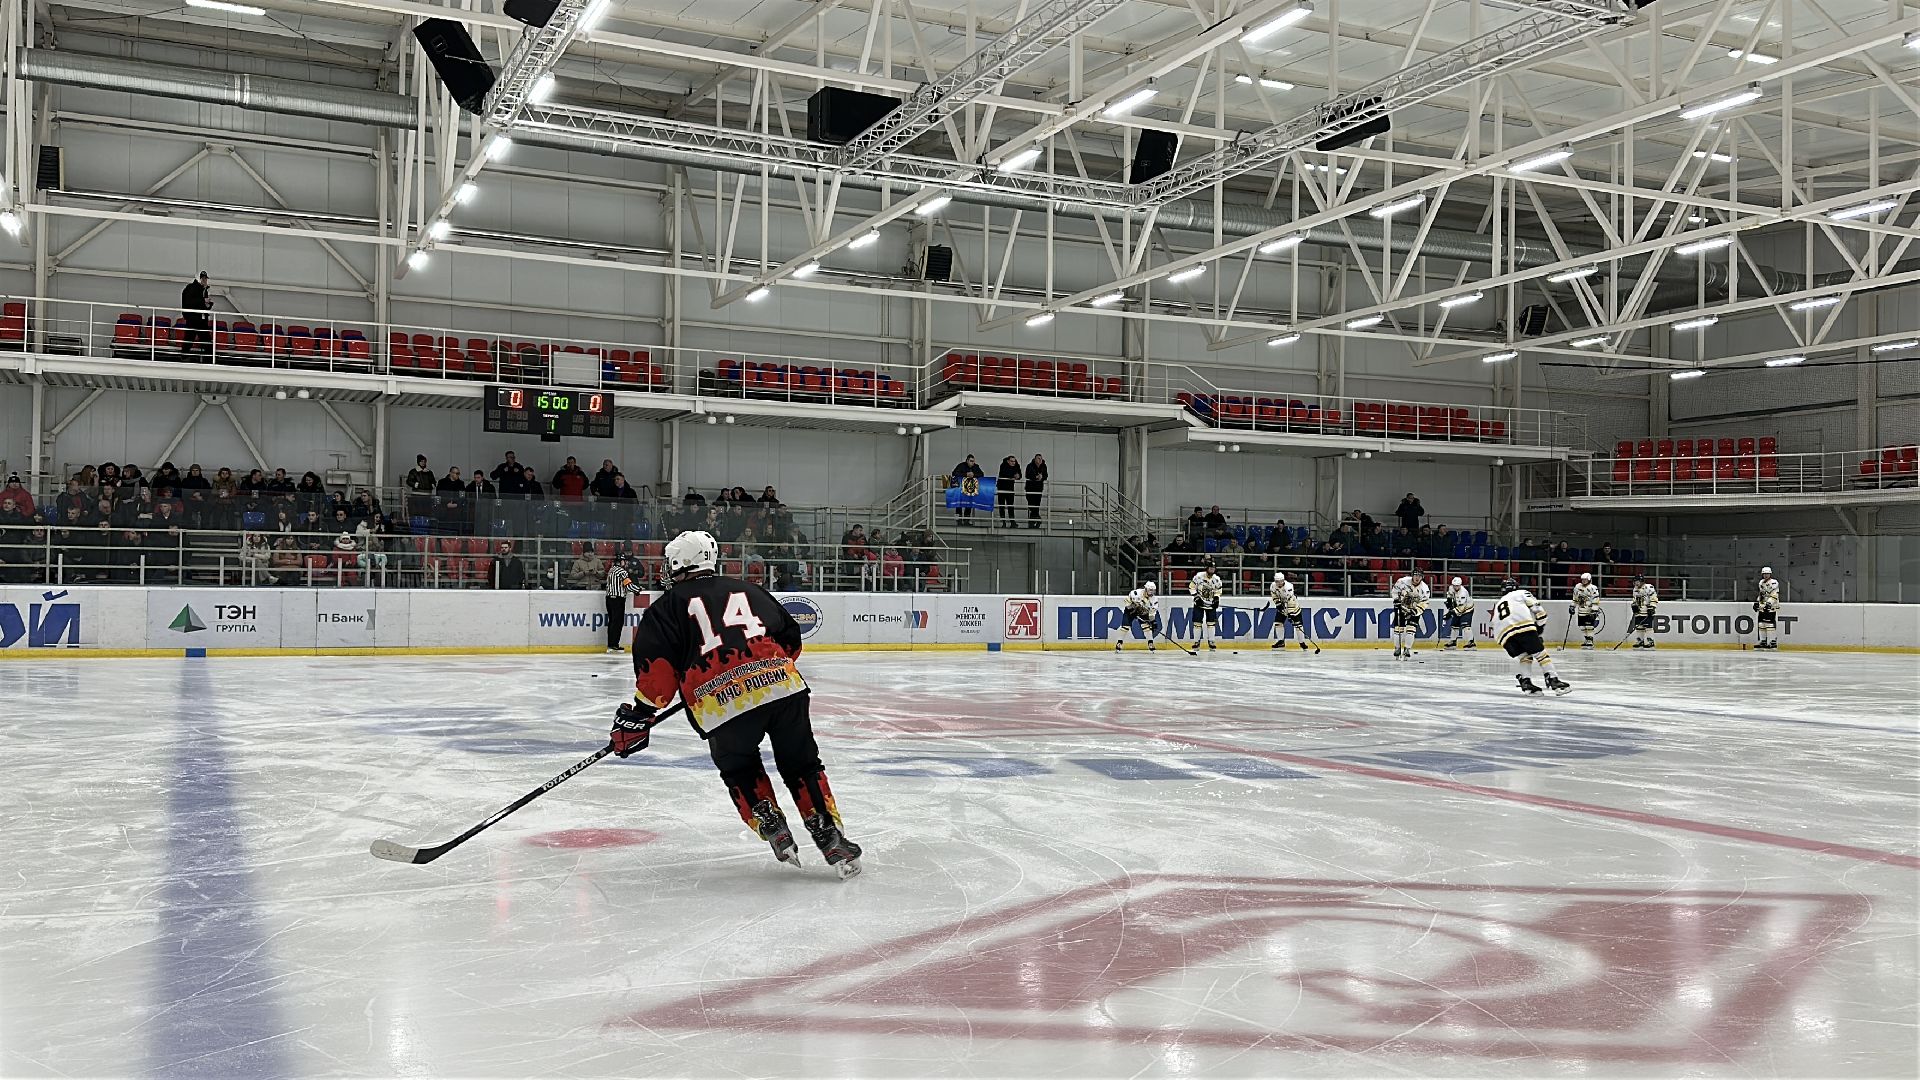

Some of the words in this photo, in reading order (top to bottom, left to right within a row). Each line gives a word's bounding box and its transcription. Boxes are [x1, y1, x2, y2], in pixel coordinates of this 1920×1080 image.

[510, 390, 520, 406] 0
[590, 395, 601, 411] 0
[214, 605, 256, 620] ТЭН
[318, 613, 328, 623] П
[331, 613, 364, 623] Банк
[852, 614, 876, 623] МСП
[879, 614, 902, 623] Банк
[1497, 600, 1511, 621] 8
[216, 624, 257, 633] ГРУППА
[687, 591, 767, 656] 14
[1627, 614, 1798, 635] ВТОПОТ
[715, 683, 742, 706] МЧС
[744, 667, 789, 693] РОССИИ
[541, 772, 569, 791] TOTAL
[569, 754, 598, 775] BLACK
